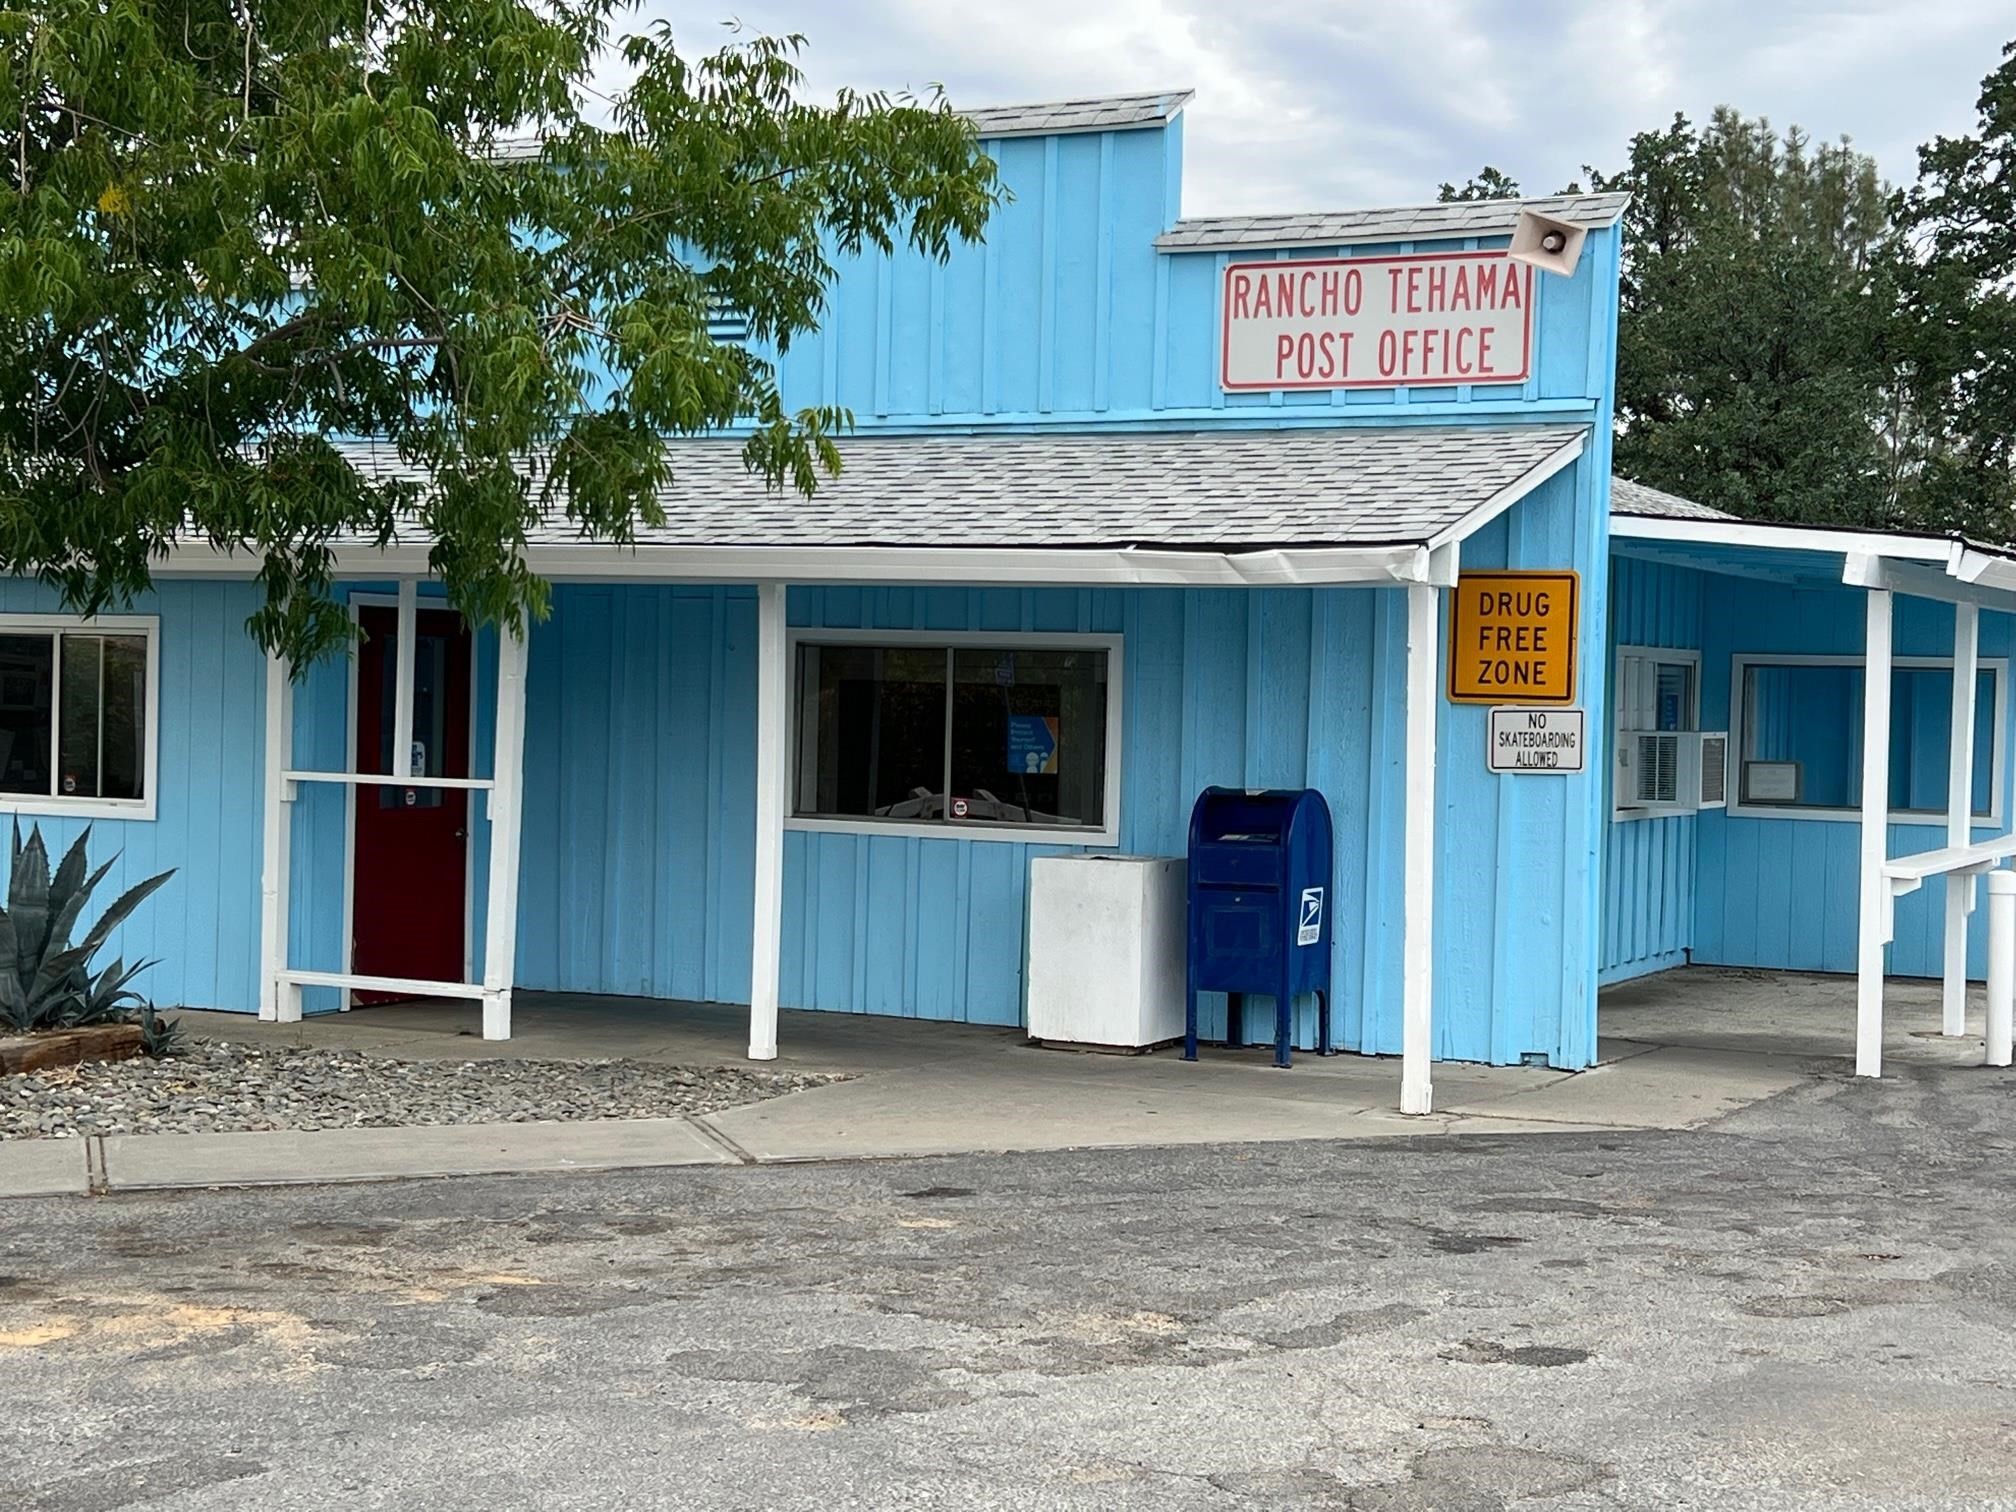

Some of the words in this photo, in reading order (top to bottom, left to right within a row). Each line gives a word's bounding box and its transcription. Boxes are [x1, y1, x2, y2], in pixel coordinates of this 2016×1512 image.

[1233, 268, 1363, 319] RANCHO
[1388, 263, 1522, 314] TEHAMA
[1276, 331, 1354, 379] POST
[1378, 327, 1495, 377] OFFICE
[1479, 592, 1550, 617] DRUG
[1479, 626, 1547, 651] FREE
[1477, 660, 1547, 685] ZONE
[1528, 713, 1546, 729] NO
[1498, 731, 1576, 749] SKATEBOARDING
[1515, 751, 1559, 768] ALLOWED
